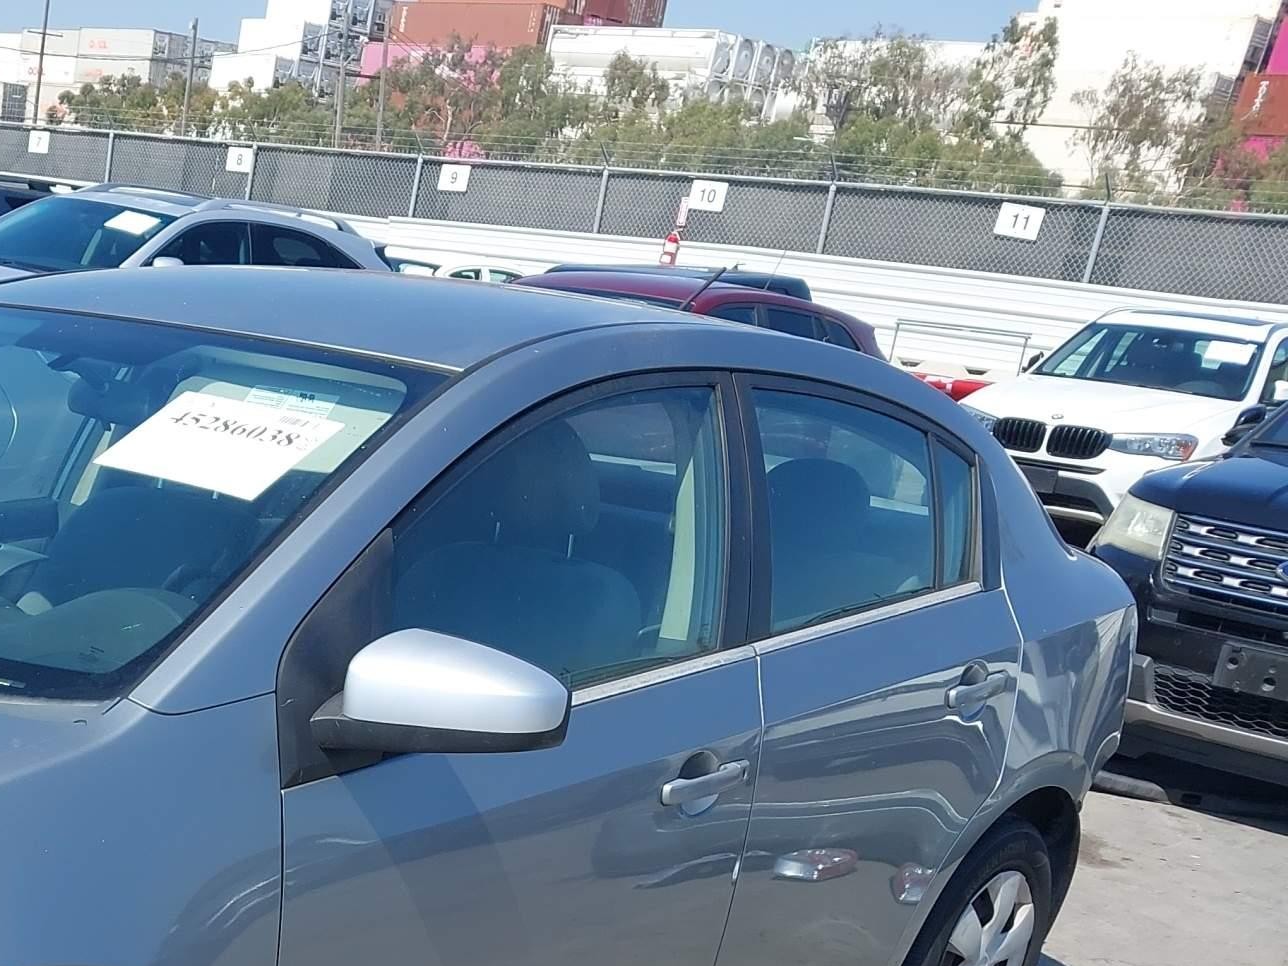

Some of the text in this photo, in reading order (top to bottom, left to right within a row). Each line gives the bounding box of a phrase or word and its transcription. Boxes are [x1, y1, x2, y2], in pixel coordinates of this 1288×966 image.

[35, 136, 43, 148] 7
[236, 153, 244, 166] 8
[449, 171, 458, 185] 9
[699, 188, 717, 203] 10
[1012, 213, 1030, 230] 11
[169, 410, 301, 446] 45286038
